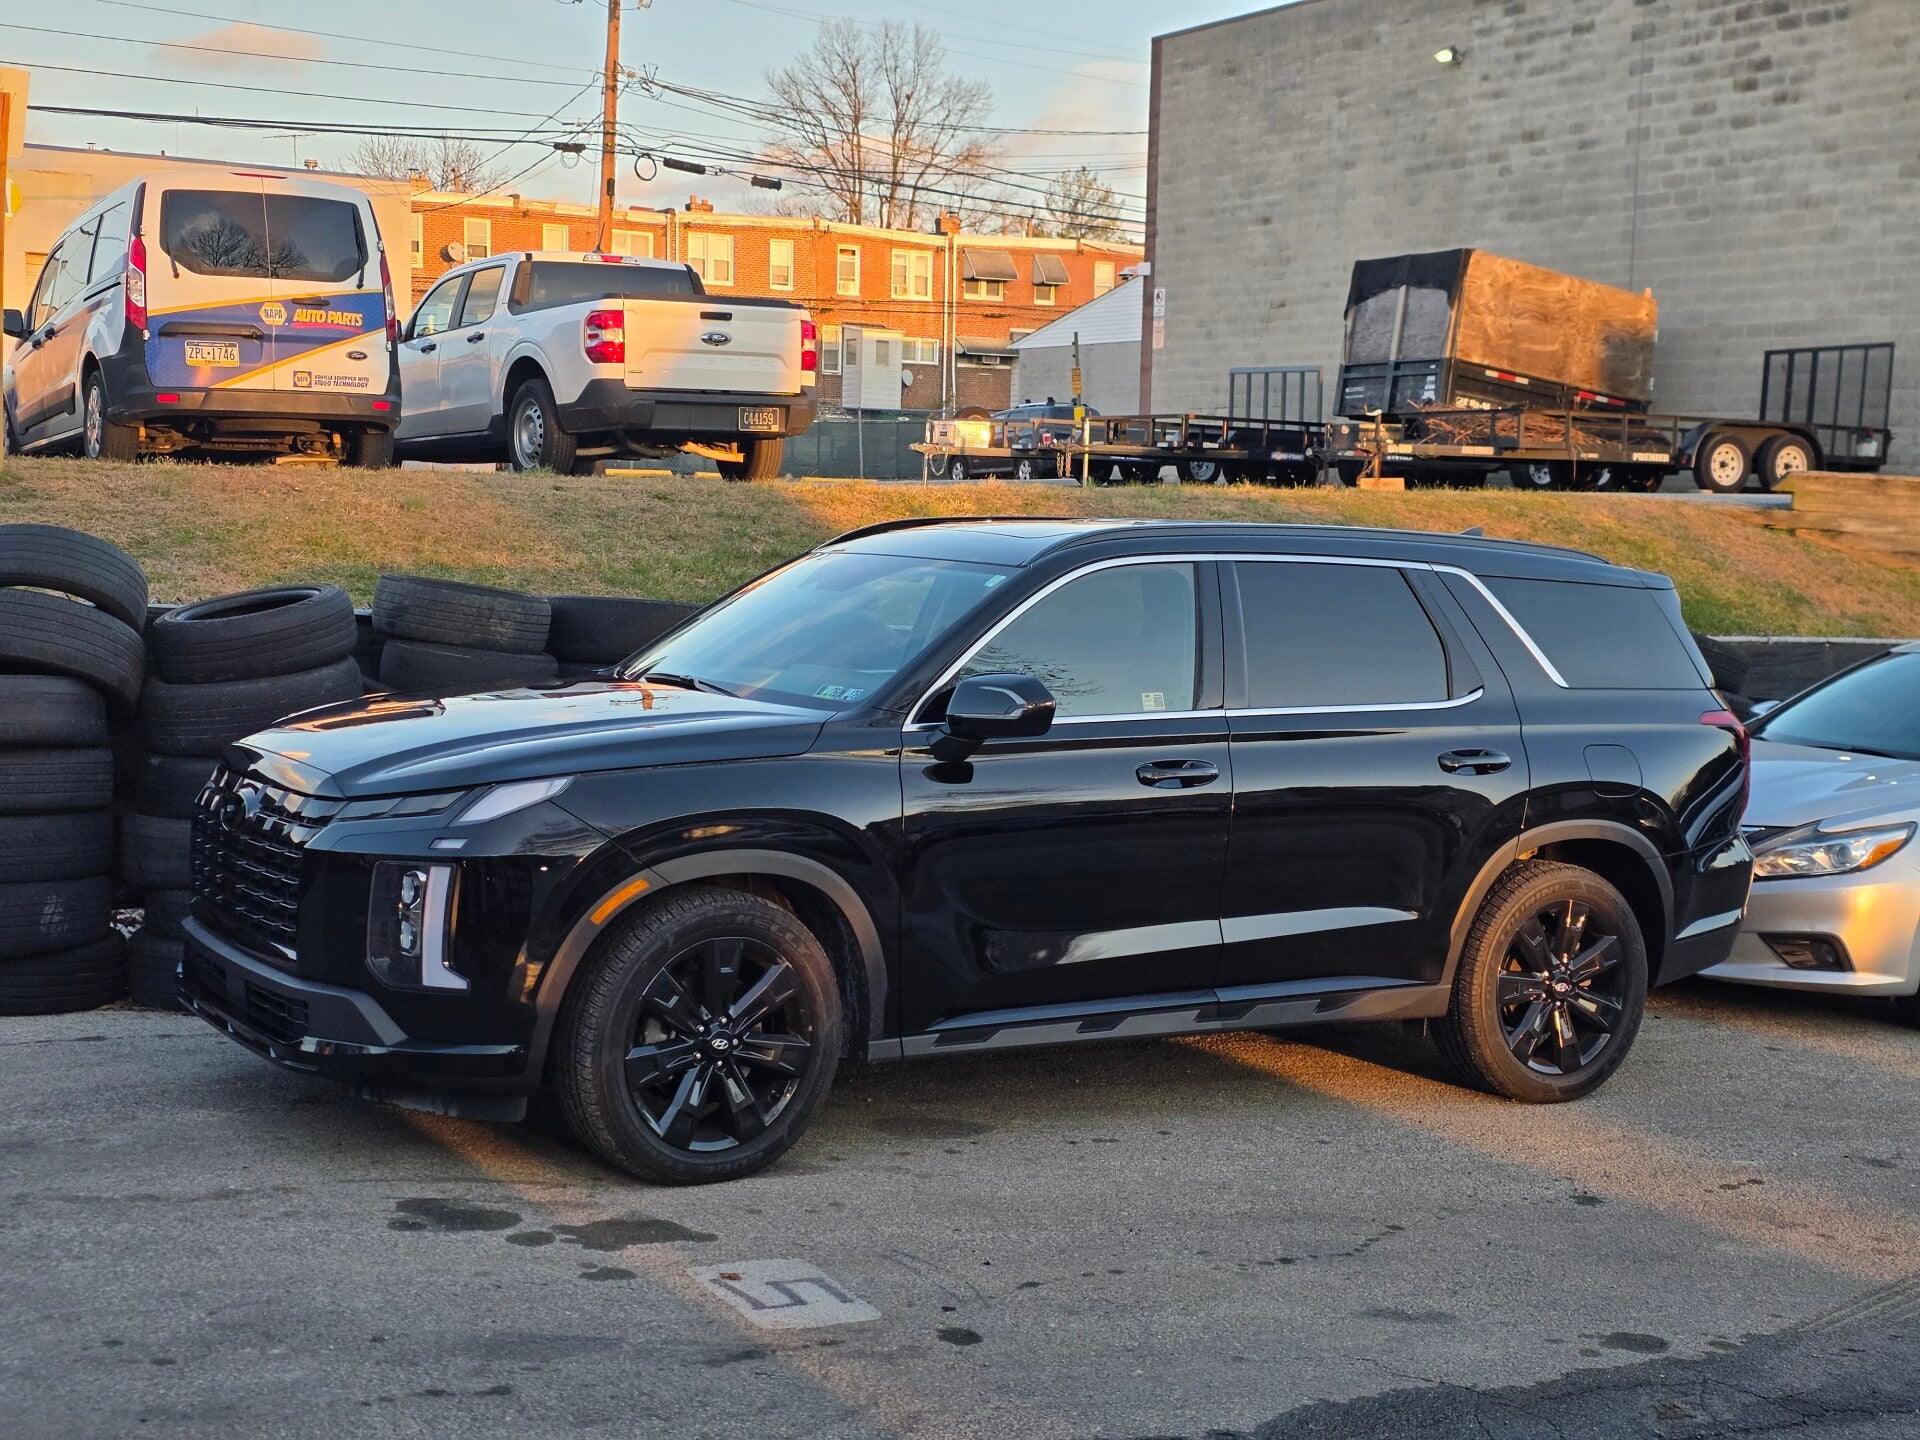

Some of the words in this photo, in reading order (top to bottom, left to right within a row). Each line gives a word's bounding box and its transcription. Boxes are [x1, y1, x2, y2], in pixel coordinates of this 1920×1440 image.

[264, 308, 283, 320] NAPA
[293, 309, 326, 323] AUTO
[328, 311, 363, 326] PARTS
[744, 412, 774, 425] C44159
[736, 914, 810, 954] KELLY
